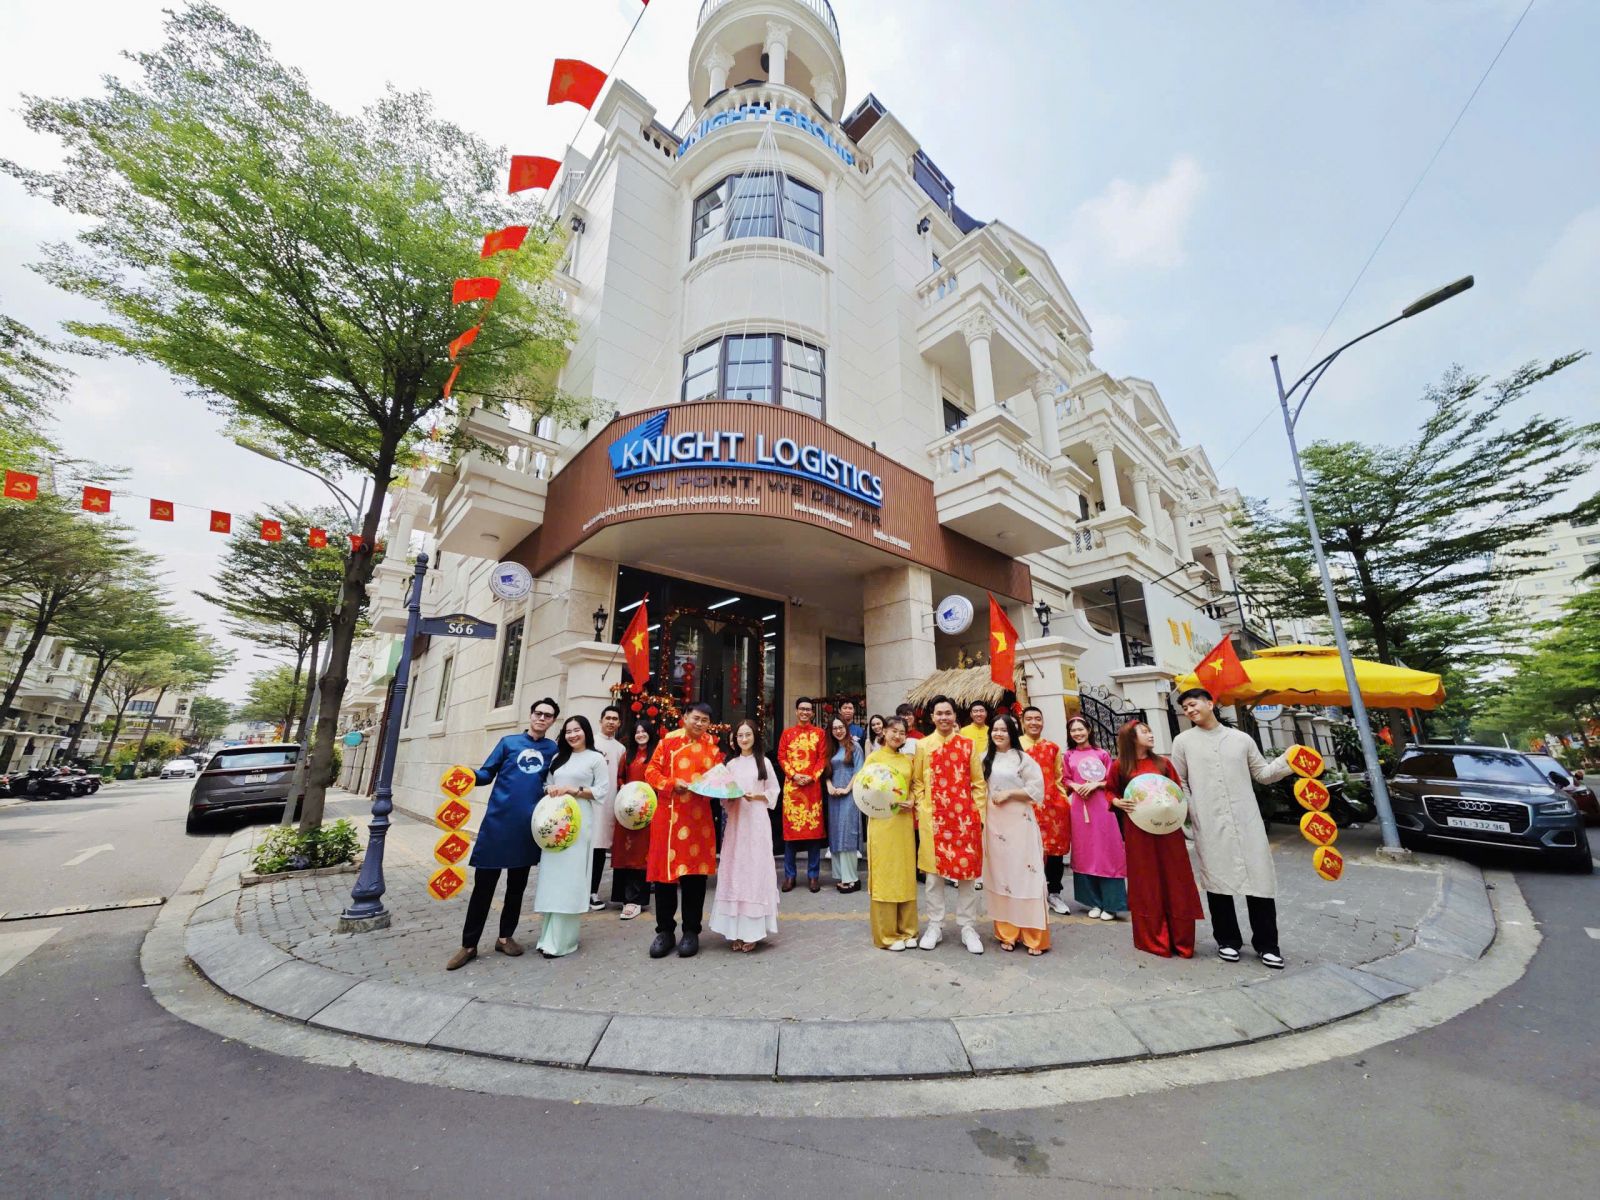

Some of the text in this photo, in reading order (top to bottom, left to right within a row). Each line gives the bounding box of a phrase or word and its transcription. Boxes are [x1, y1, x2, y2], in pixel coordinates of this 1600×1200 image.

[677, 106, 855, 165] KNIGHT GROUP
[621, 430, 884, 500] KNIGHT LOGISTICS
[620, 477, 667, 496] YOU
[767, 479, 804, 497] WE
[810, 488, 881, 526] DELIVER
[448, 622, 474, 635] Số 6
